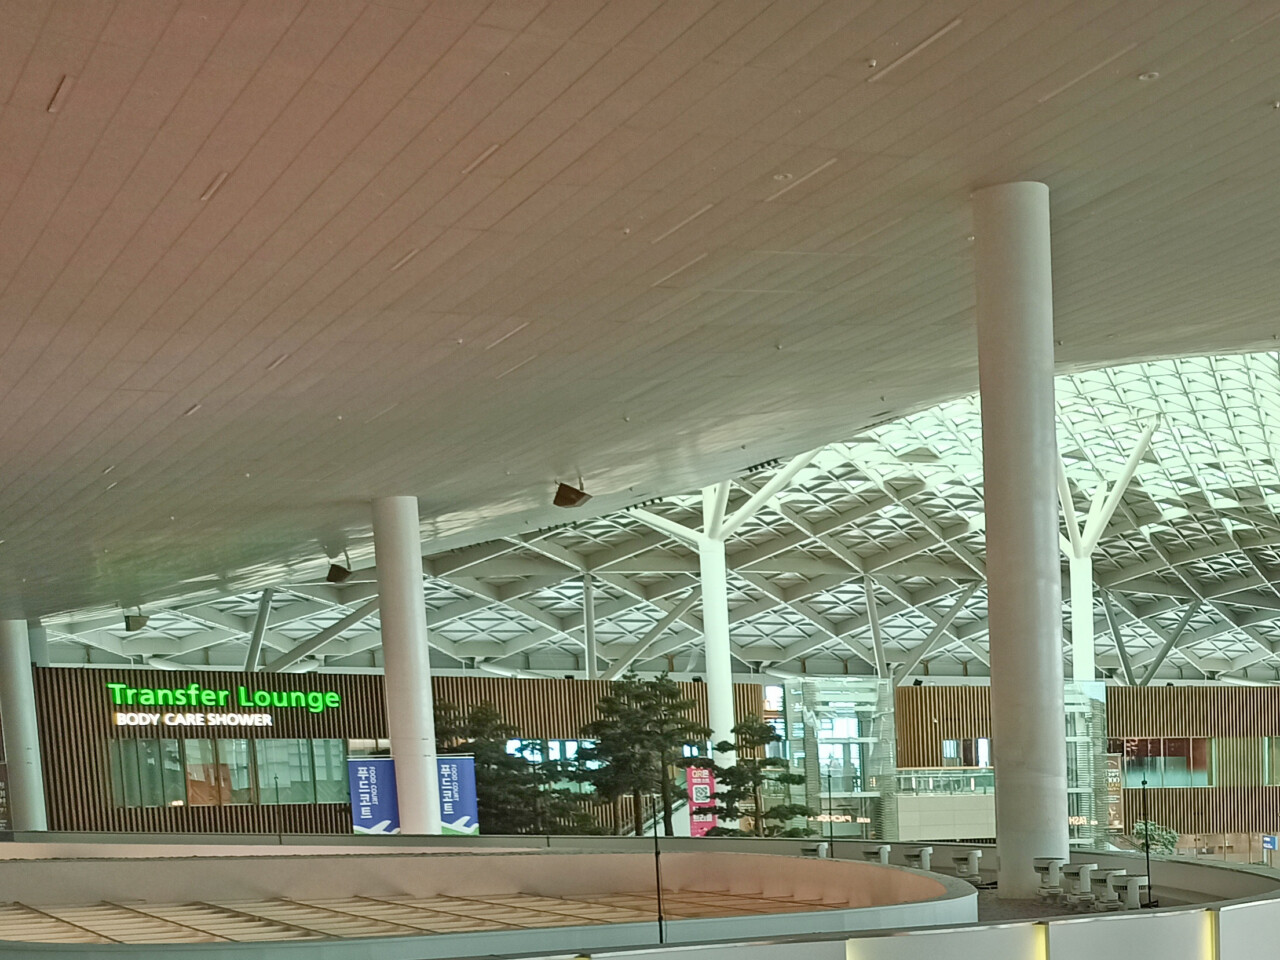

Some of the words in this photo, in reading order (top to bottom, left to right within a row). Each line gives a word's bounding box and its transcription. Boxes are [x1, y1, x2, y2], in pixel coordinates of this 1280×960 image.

[107, 683, 229, 706] Transfer
[238, 686, 341, 712] Lounge
[115, 713, 160, 725] BODY
[164, 713, 205, 726] CARE
[207, 714, 272, 726] SHOWER
[368, 766, 377, 783] FOOD
[357, 766, 373, 819] 푸드코트
[371, 785, 379, 805] COURT
[440, 764, 454, 814] 푸드코트
